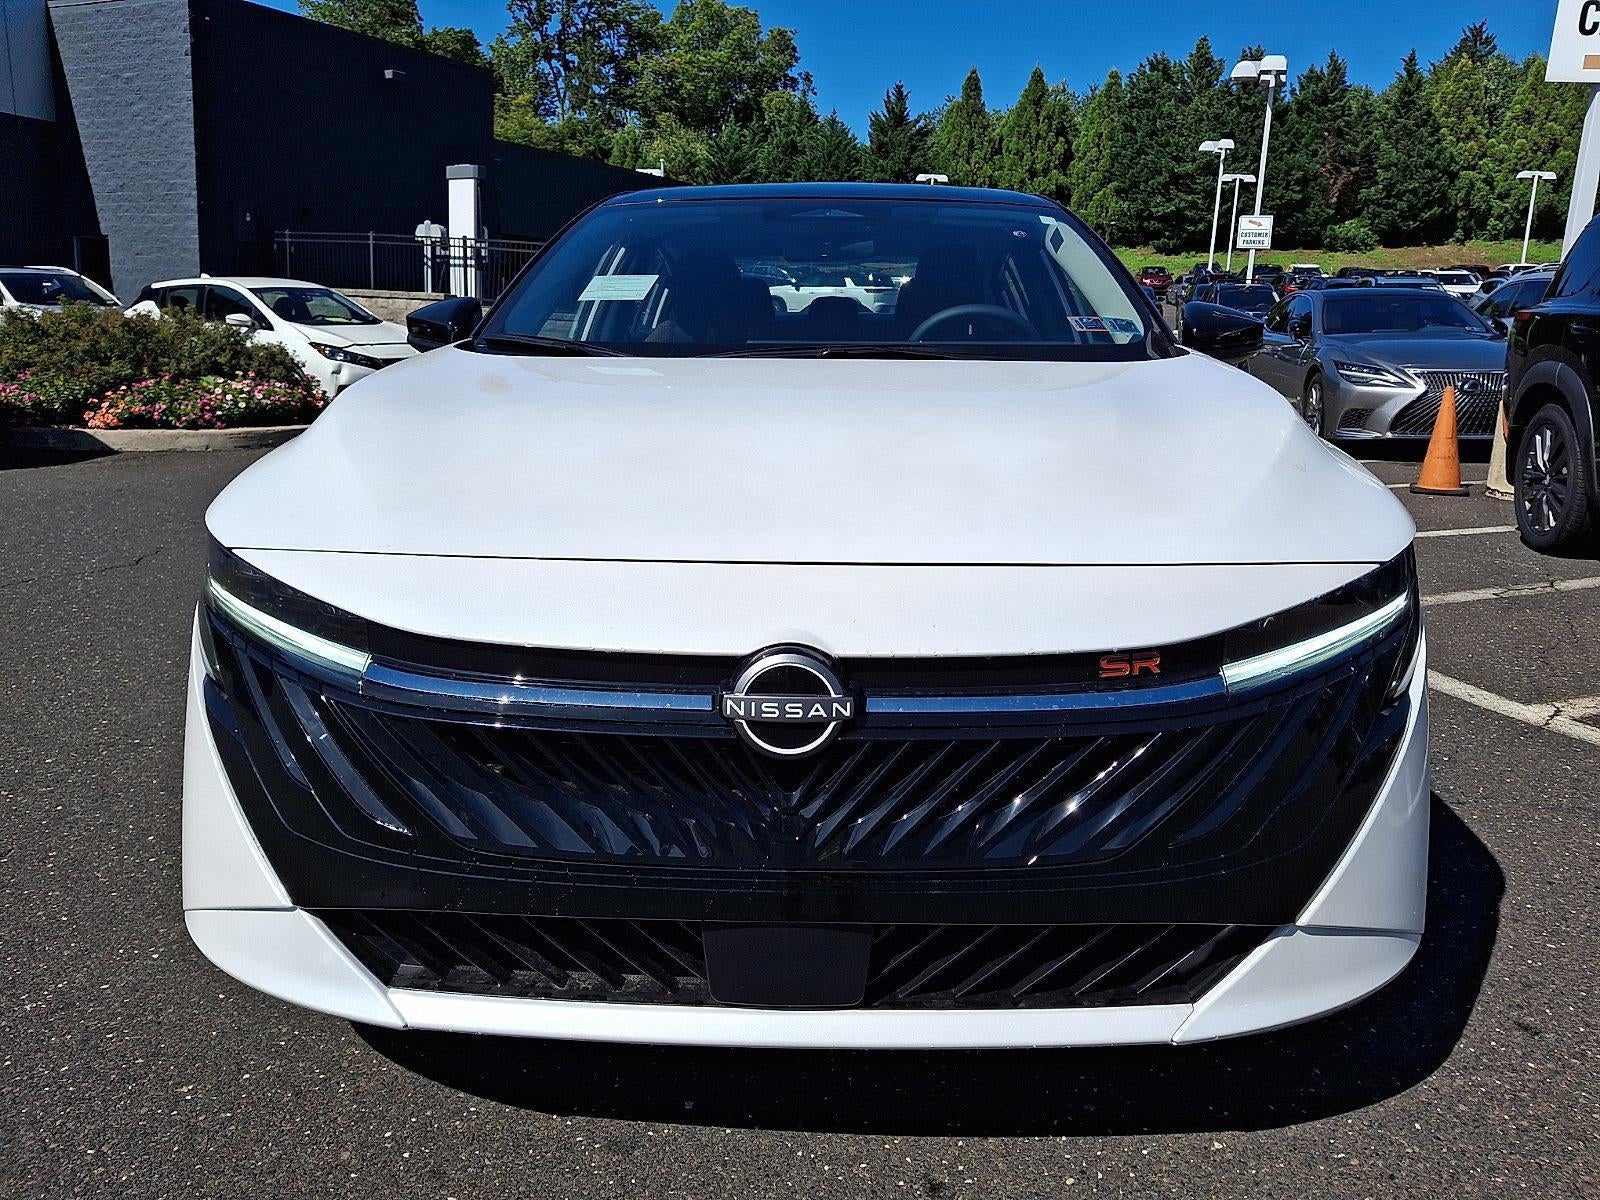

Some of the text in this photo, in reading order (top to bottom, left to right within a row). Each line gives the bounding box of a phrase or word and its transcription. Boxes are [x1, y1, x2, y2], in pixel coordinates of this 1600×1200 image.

[1579, 0, 1600, 36] C
[1099, 652, 1160, 677] SR
[726, 699, 851, 718] NISSAN
